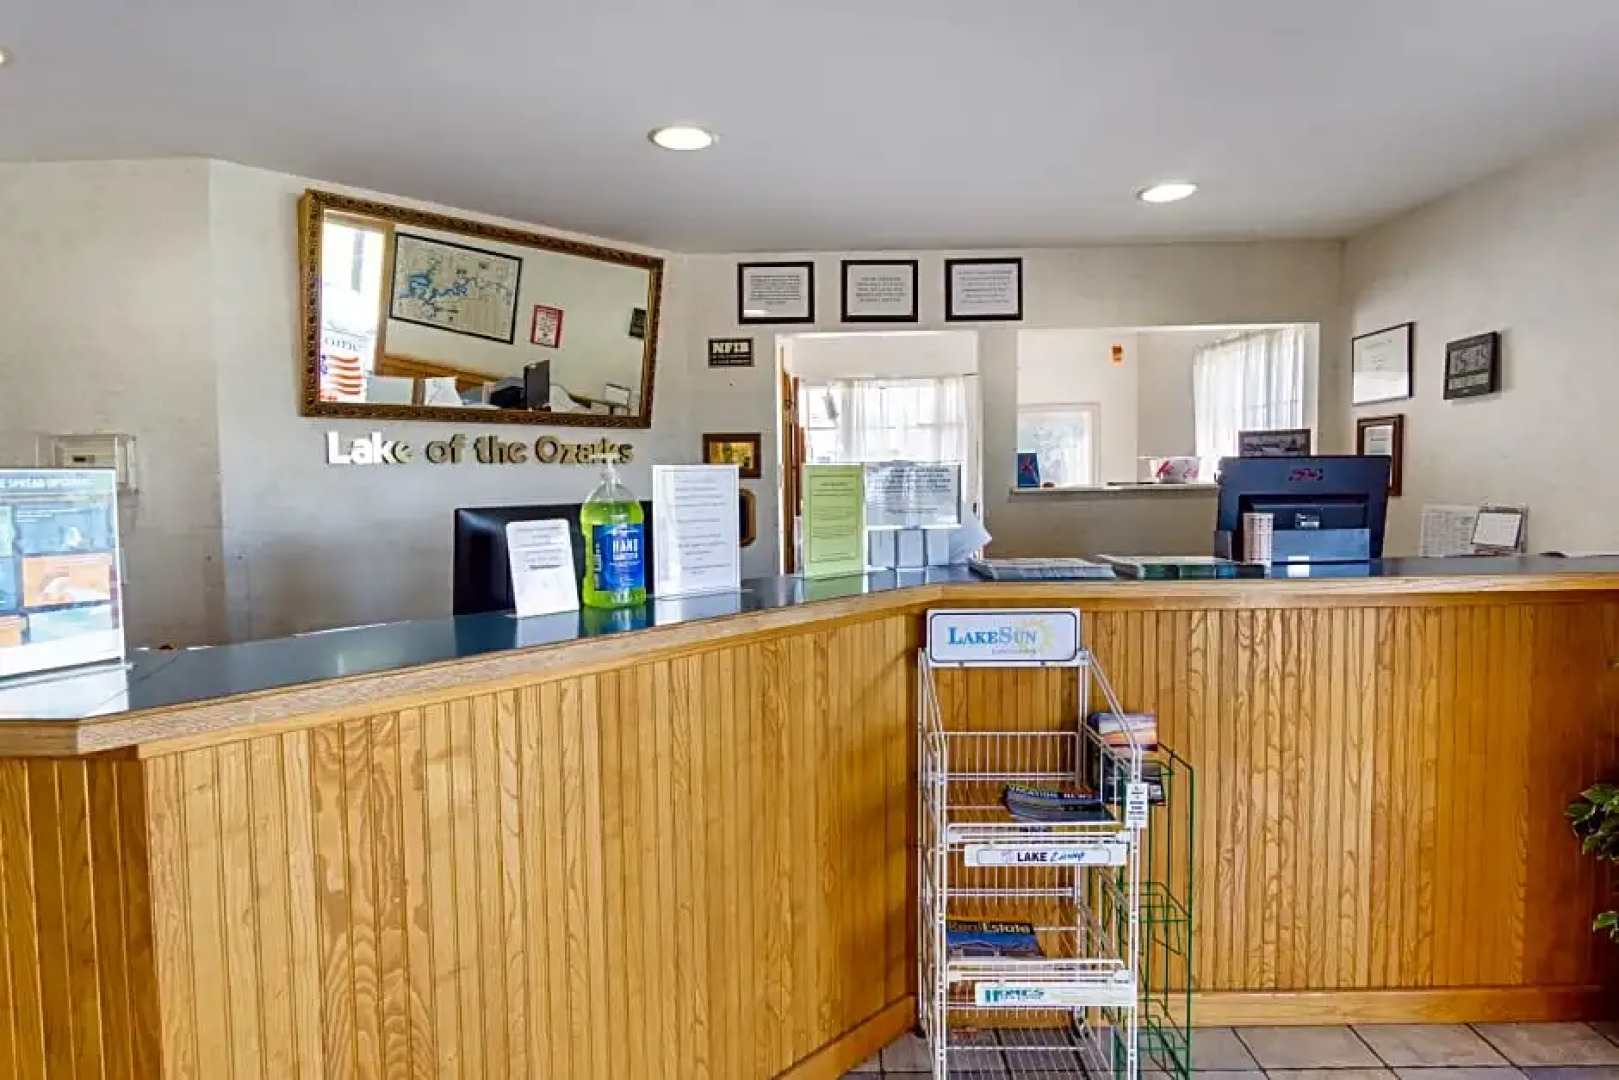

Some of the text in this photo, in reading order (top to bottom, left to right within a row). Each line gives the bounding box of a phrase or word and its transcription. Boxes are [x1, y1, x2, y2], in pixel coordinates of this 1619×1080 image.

[327, 430, 635, 465] Lake of the Ozarks
[1017, 851, 1048, 862] LAKE
